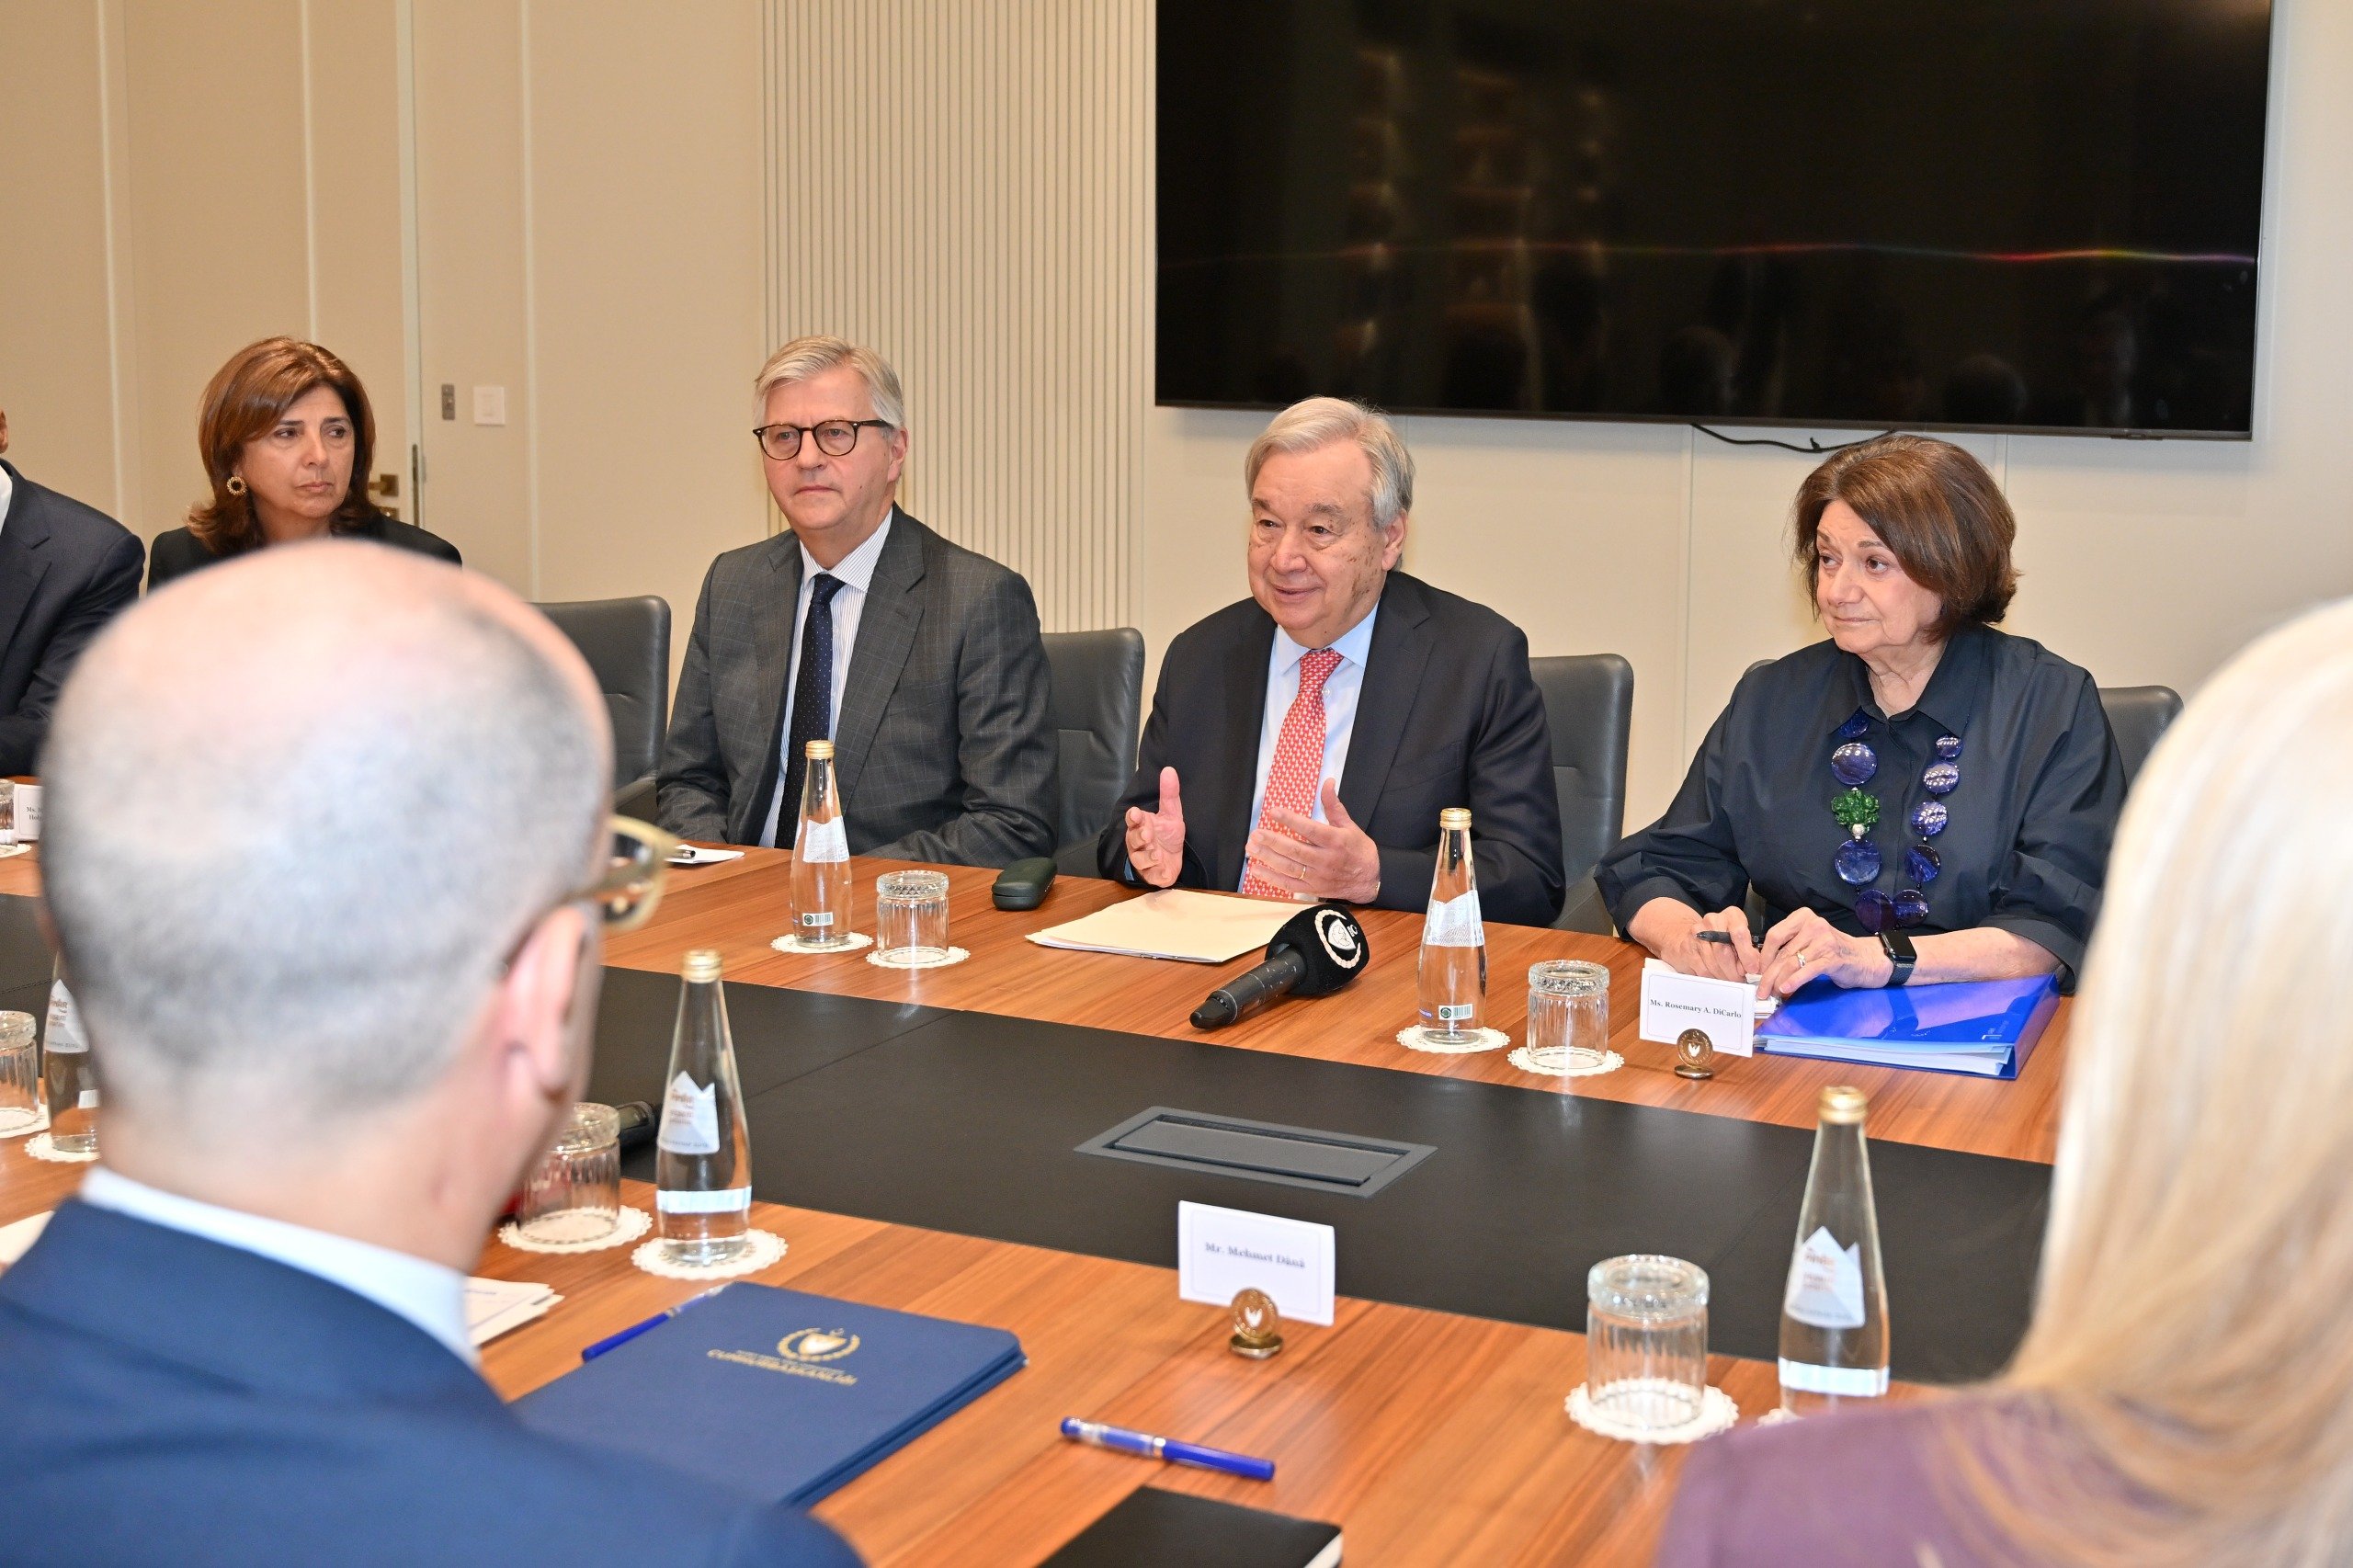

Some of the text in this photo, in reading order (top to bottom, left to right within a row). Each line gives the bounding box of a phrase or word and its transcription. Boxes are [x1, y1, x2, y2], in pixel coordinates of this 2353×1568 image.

[1650, 999, 1663, 1007] Ms.
[1665, 1001, 1701, 1014] Rosemary
[1713, 1007, 1742, 1018] DiCarlo
[1204, 1242, 1224, 1254] Mr.
